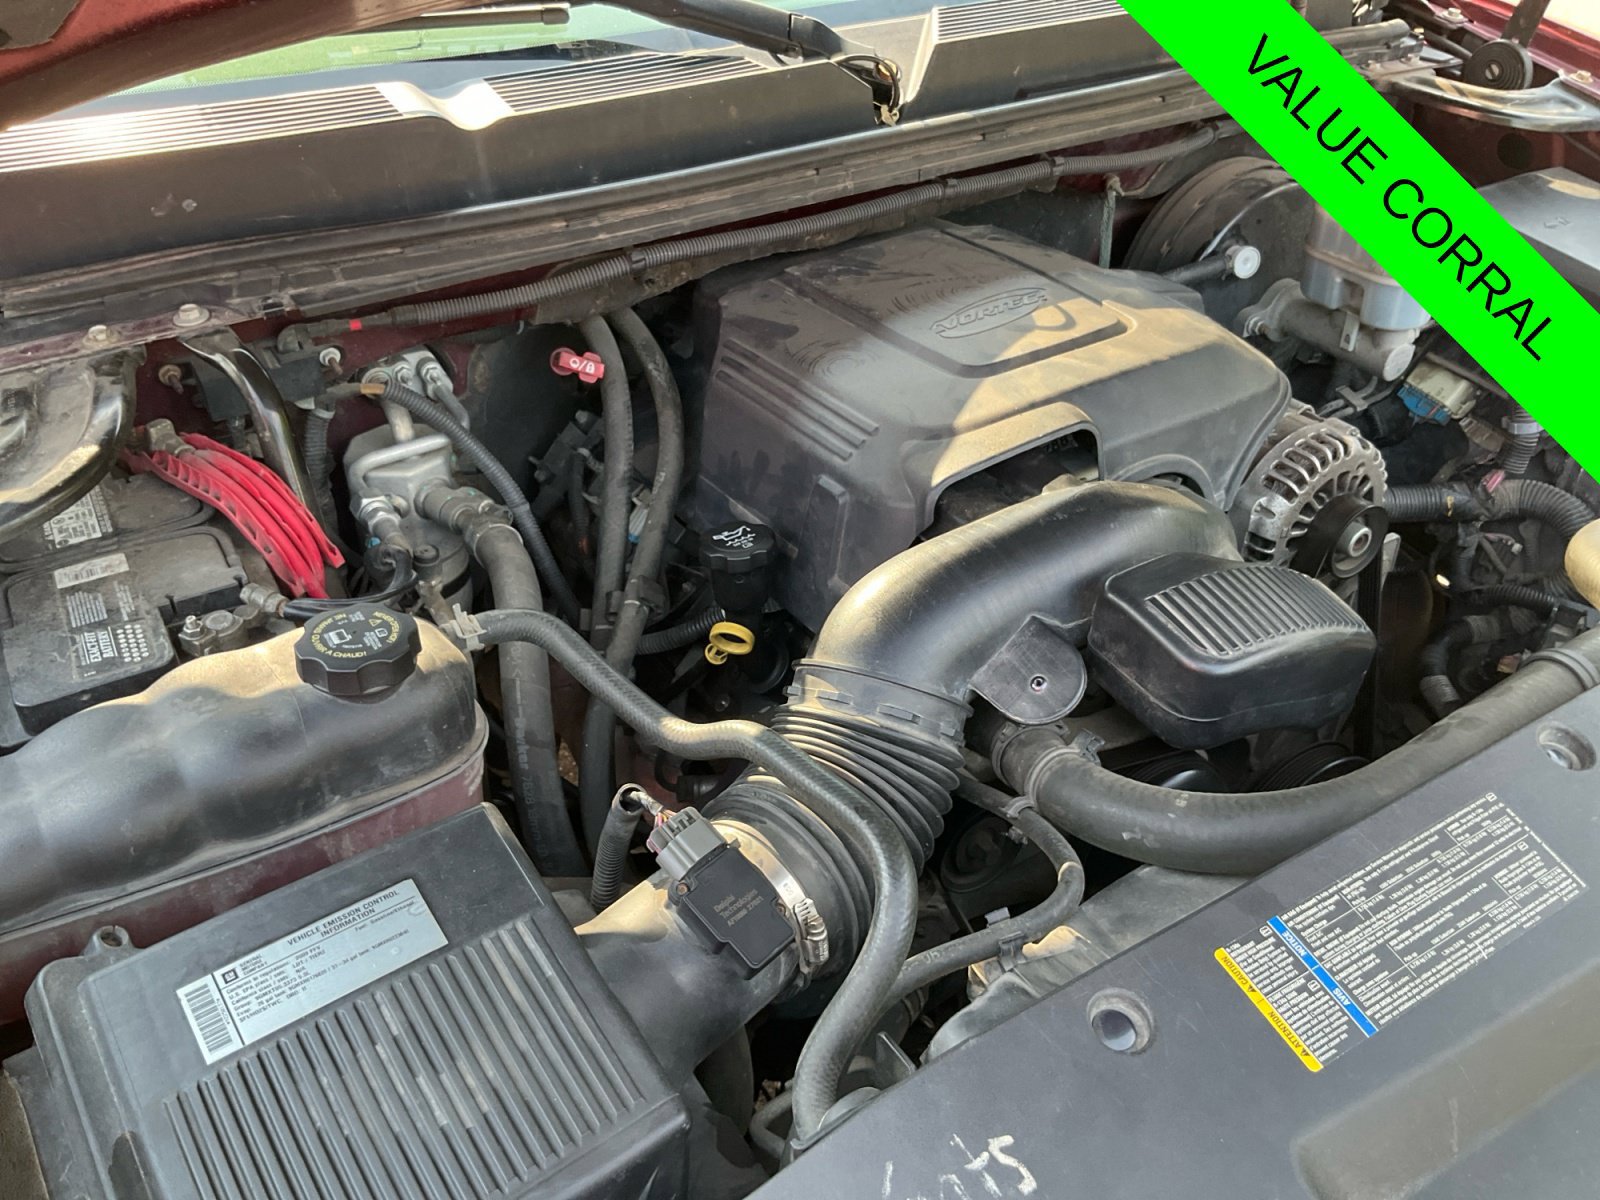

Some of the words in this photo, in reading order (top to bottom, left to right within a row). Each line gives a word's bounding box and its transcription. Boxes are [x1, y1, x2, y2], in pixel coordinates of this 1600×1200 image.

[286, 925, 320, 946] VEHICLE
[321, 906, 362, 929] EMISSION
[362, 888, 399, 910] CONTROL
[319, 907, 376, 938] INFORMATION
[1281, 930, 1308, 957] NOTICE
[1221, 955, 1249, 986] CAUTION
[1332, 987, 1351, 1006] AVIS
[1267, 1010, 1302, 1049] ATTENTION
